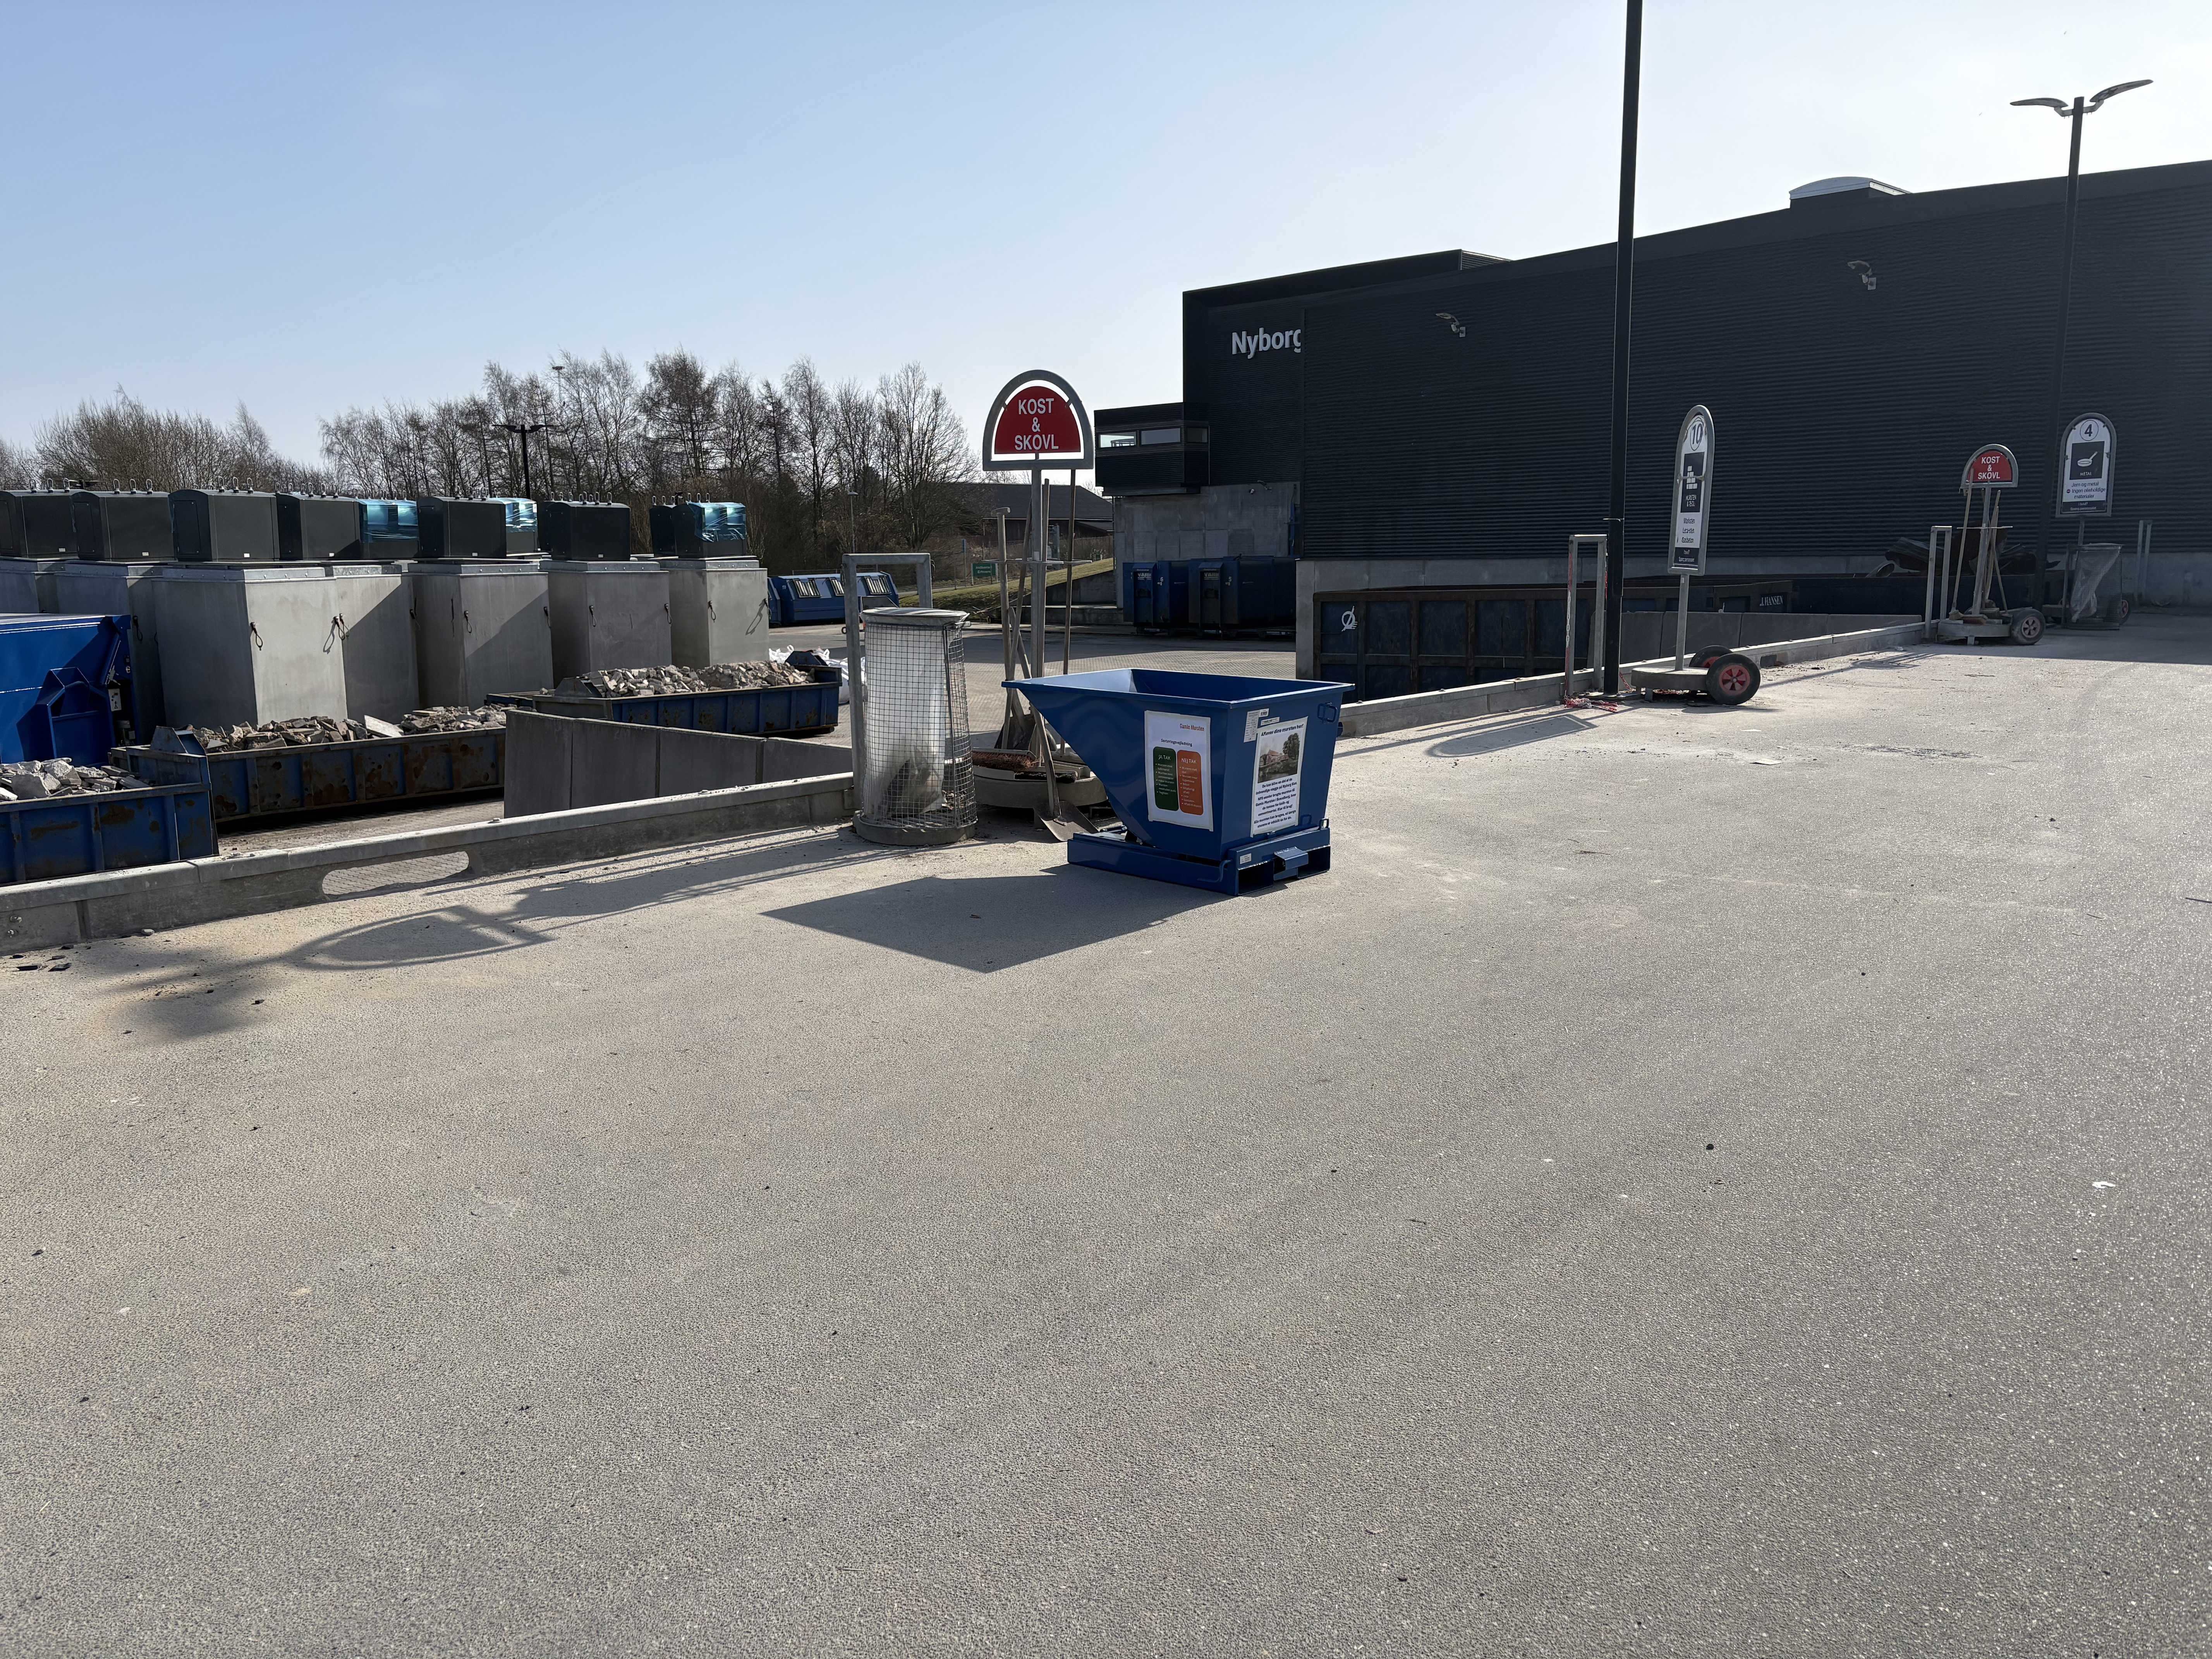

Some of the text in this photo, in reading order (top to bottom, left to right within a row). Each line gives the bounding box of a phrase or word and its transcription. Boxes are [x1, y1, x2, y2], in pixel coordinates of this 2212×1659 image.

[1018, 398, 1054, 414] KOST
[1032, 417, 1041, 432] &
[2084, 424, 2093, 437] 4
[1015, 434, 1059, 450] SKOVL
[1692, 424, 1703, 444] 10
